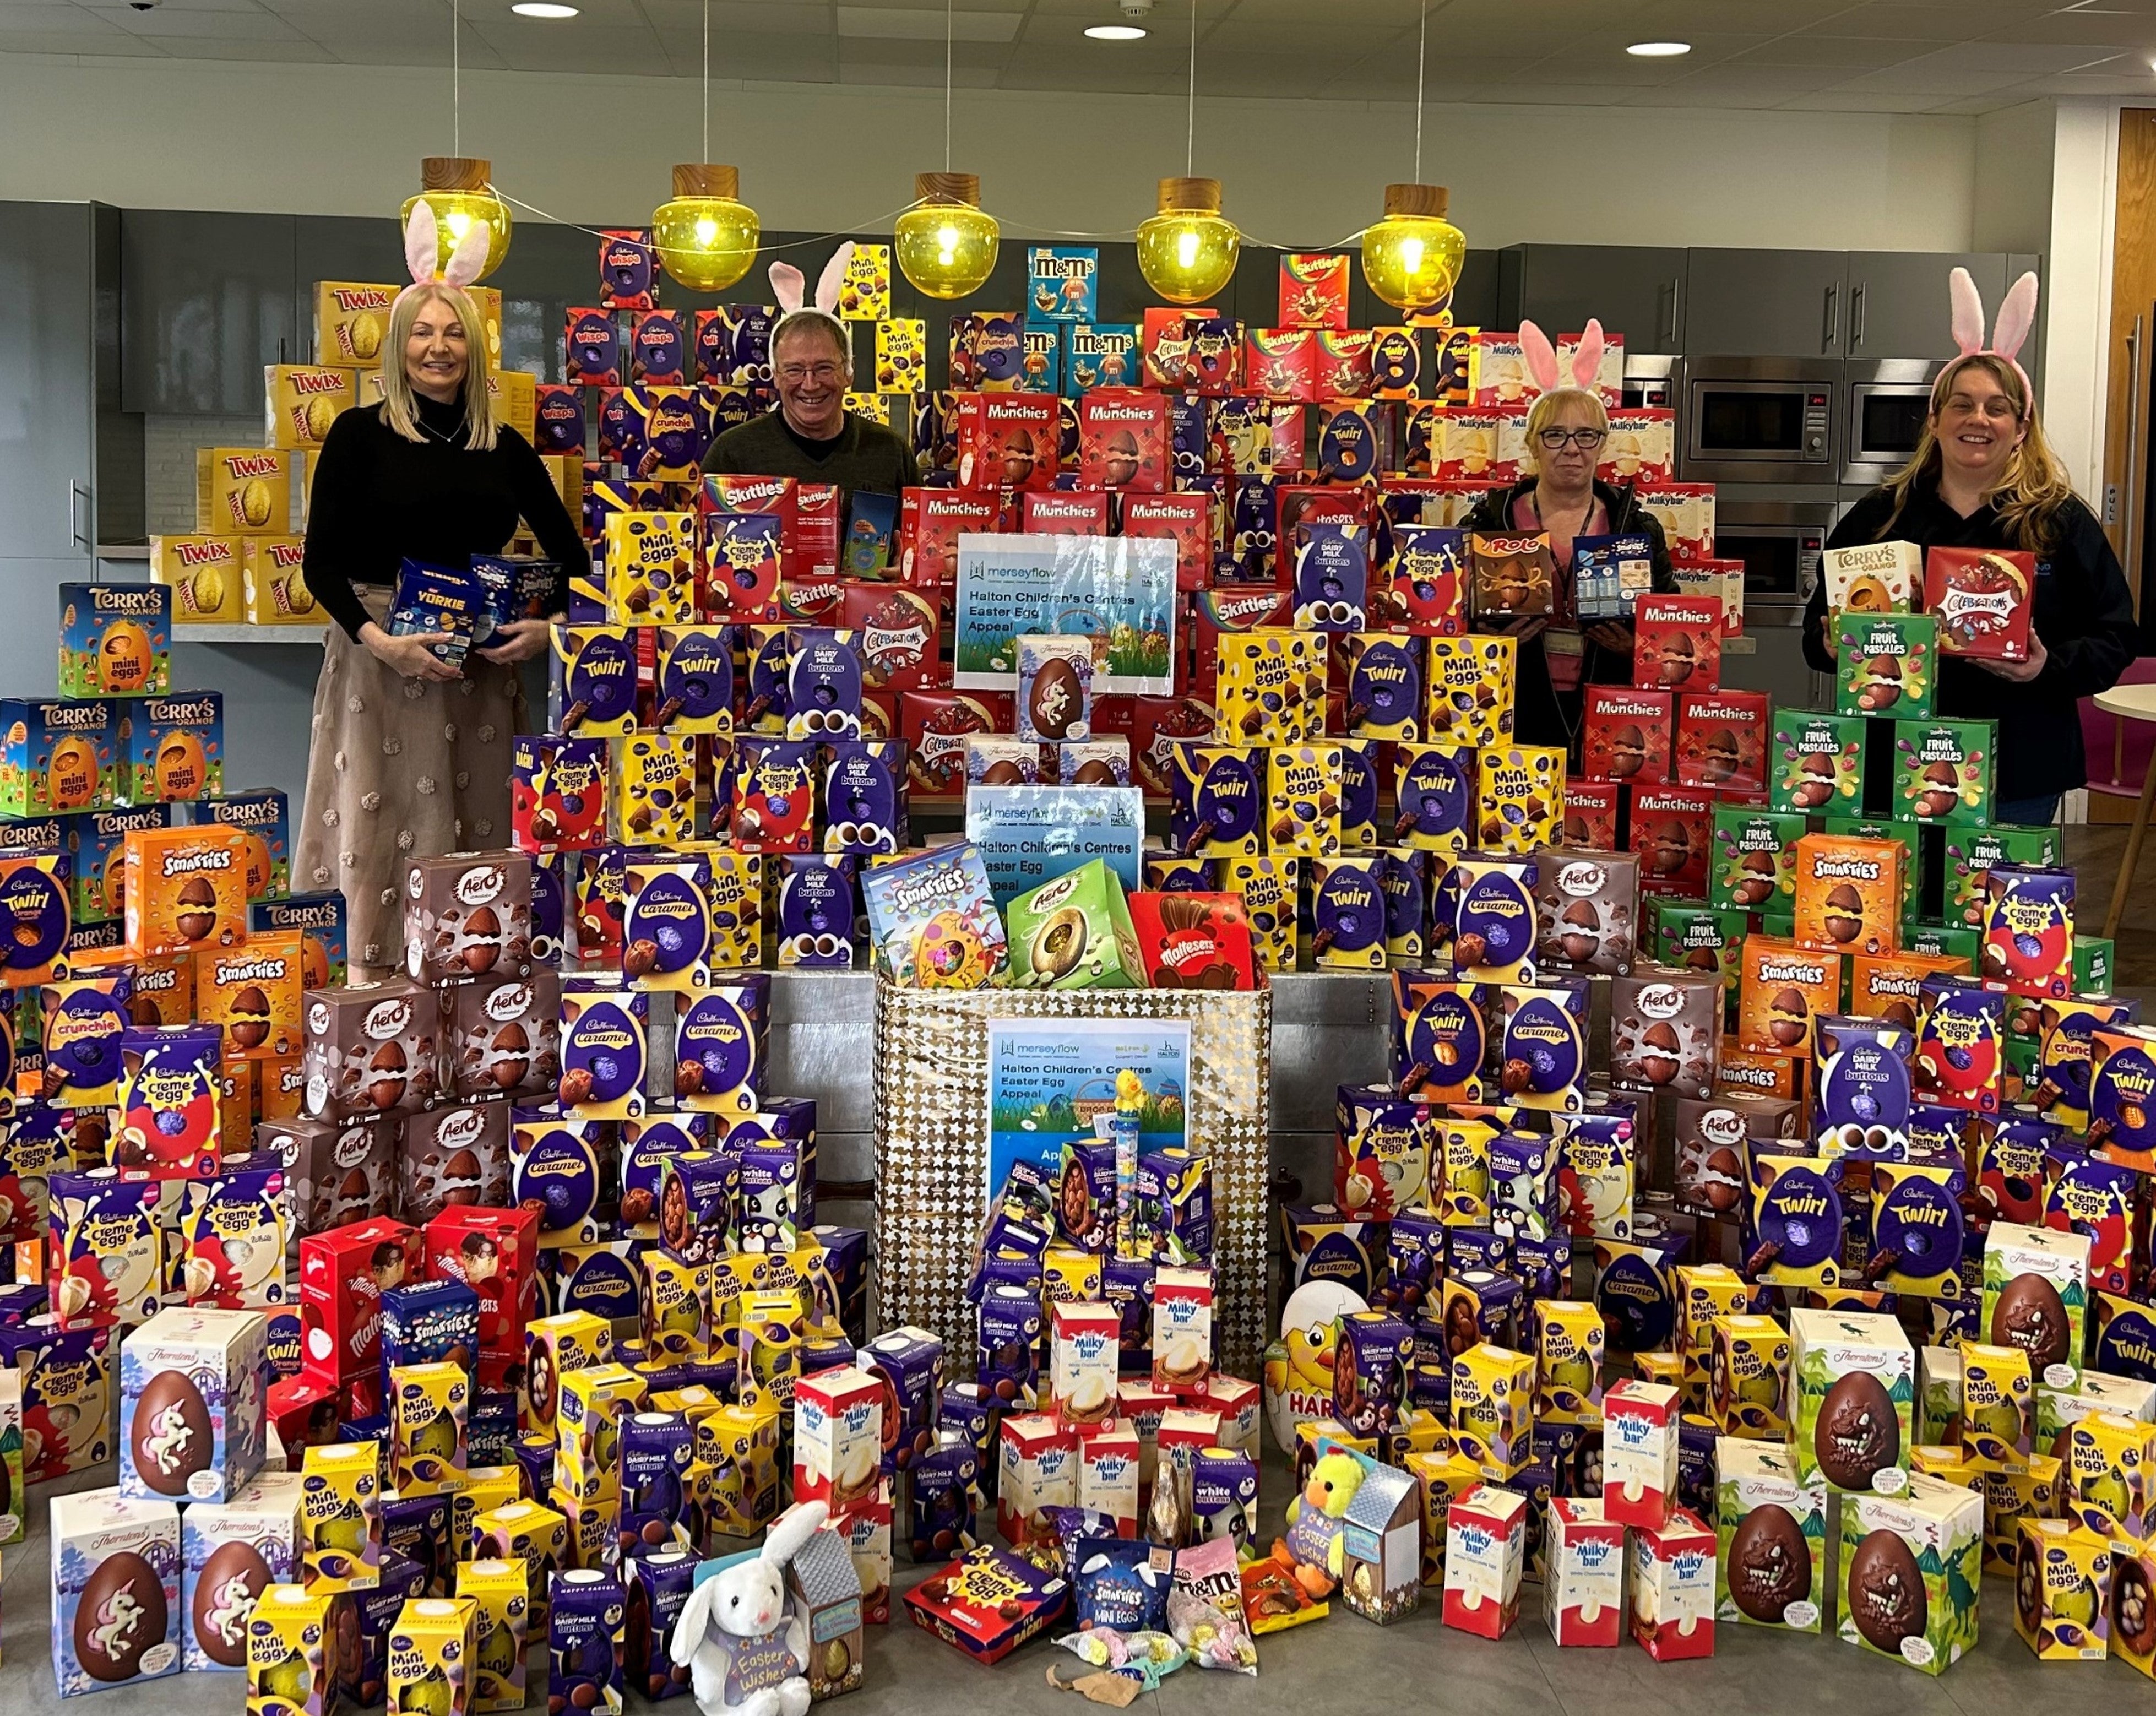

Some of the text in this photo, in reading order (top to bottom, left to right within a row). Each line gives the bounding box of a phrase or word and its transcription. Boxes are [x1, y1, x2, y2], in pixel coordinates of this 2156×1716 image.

[1296, 257, 1339, 275] Skittles
[887, 333, 911, 344] Mini
[887, 342, 914, 352] eggs
[987, 405, 1047, 419] Munchies
[656, 417, 691, 428] crunchie
[1458, 418, 1496, 430] Milkybar
[1609, 420, 1649, 431] Milkybar
[726, 482, 785, 506] Skittles
[797, 491, 832, 507] Skittles
[927, 502, 990, 515] Munchies
[1131, 504, 1196, 518] Munchies
[639, 531, 673, 549] Mini
[640, 546, 678, 562] eggs
[1315, 557, 1349, 567] buttons
[1861, 561, 1897, 571] ORANGE
[988, 567, 1056, 579] merseyflow
[418, 590, 465, 611] YORKIE
[970, 591, 1011, 601] Halton
[970, 607, 1039, 618] Easter Egg
[1218, 596, 1277, 620] Skittles
[1644, 607, 1712, 624] Munchies
[969, 622, 1013, 632] Appeal
[112, 657, 139, 670] mini
[1254, 656, 1286, 674] Mini
[112, 667, 140, 678] eggs
[1255, 670, 1290, 686] eggs
[1688, 705, 1756, 721] Munchies
[643, 754, 676, 772] Mini
[644, 768, 681, 784] eggs
[841, 775, 876, 786] buttons
[564, 778, 582, 788] egg
[980, 842, 1017, 852] Halton
[1084, 843, 1131, 853] Centres
[1020, 861, 1042, 873] Egg
[990, 880, 1018, 892] peal
[641, 903, 693, 914] Caramel
[1471, 899, 1520, 912] Caramel
[297, 919, 337, 928] ORANGE
[2017, 915, 2041, 928] egg
[1160, 940, 1214, 967] Maltesers
[57, 1019, 115, 1035] crunchie
[1514, 1025, 1565, 1038] Caramel
[1018, 1045, 1079, 1054] merseyflow
[1853, 1055, 1881, 1063] DAIRY
[1002, 1065, 1152, 1074] Halton Children's Cetres
[1855, 1062, 1877, 1071] MILK
[1845, 1069, 1888, 1082] buttons
[1042, 1078, 1065, 1087] Egg
[155, 1088, 183, 1101] egg
[1001, 1090, 1041, 1099] Appeal
[1449, 1144, 1471, 1156] Mini
[1449, 1155, 1474, 1165] eggs
[1493, 1159, 1520, 1167] white
[99, 1233, 126, 1247] egg
[1168, 1302, 1196, 1315] Milky
[1173, 1313, 1190, 1323] bar
[1545, 1337, 1572, 1348] Mini
[1546, 1345, 1576, 1356] eggs
[403, 1399, 432, 1413] Mini
[1289, 1394, 1332, 1416] HAR
[403, 1408, 437, 1424] eggs
[843, 1407, 871, 1425] Milky
[850, 1419, 866, 1431] bar
[1616, 1420, 1650, 1436] Milky
[1623, 1433, 1642, 1445] bar
[2074, 1447, 2103, 1459] Mini
[2074, 1459, 2108, 1471] eggs
[305, 1488, 339, 1506] Mini
[1197, 1487, 1230, 1497] white
[307, 1502, 343, 1518] eggs
[1298, 1525, 1329, 1549] Easter
[1672, 1557, 1703, 1570] Milky
[1679, 1568, 1696, 1579] bar
[965, 1582, 997, 1599] egg
[1095, 1610, 1138, 1622] MINI EGGS
[557, 1624, 593, 1632] buttons
[737, 1650, 785, 1672] Easter
